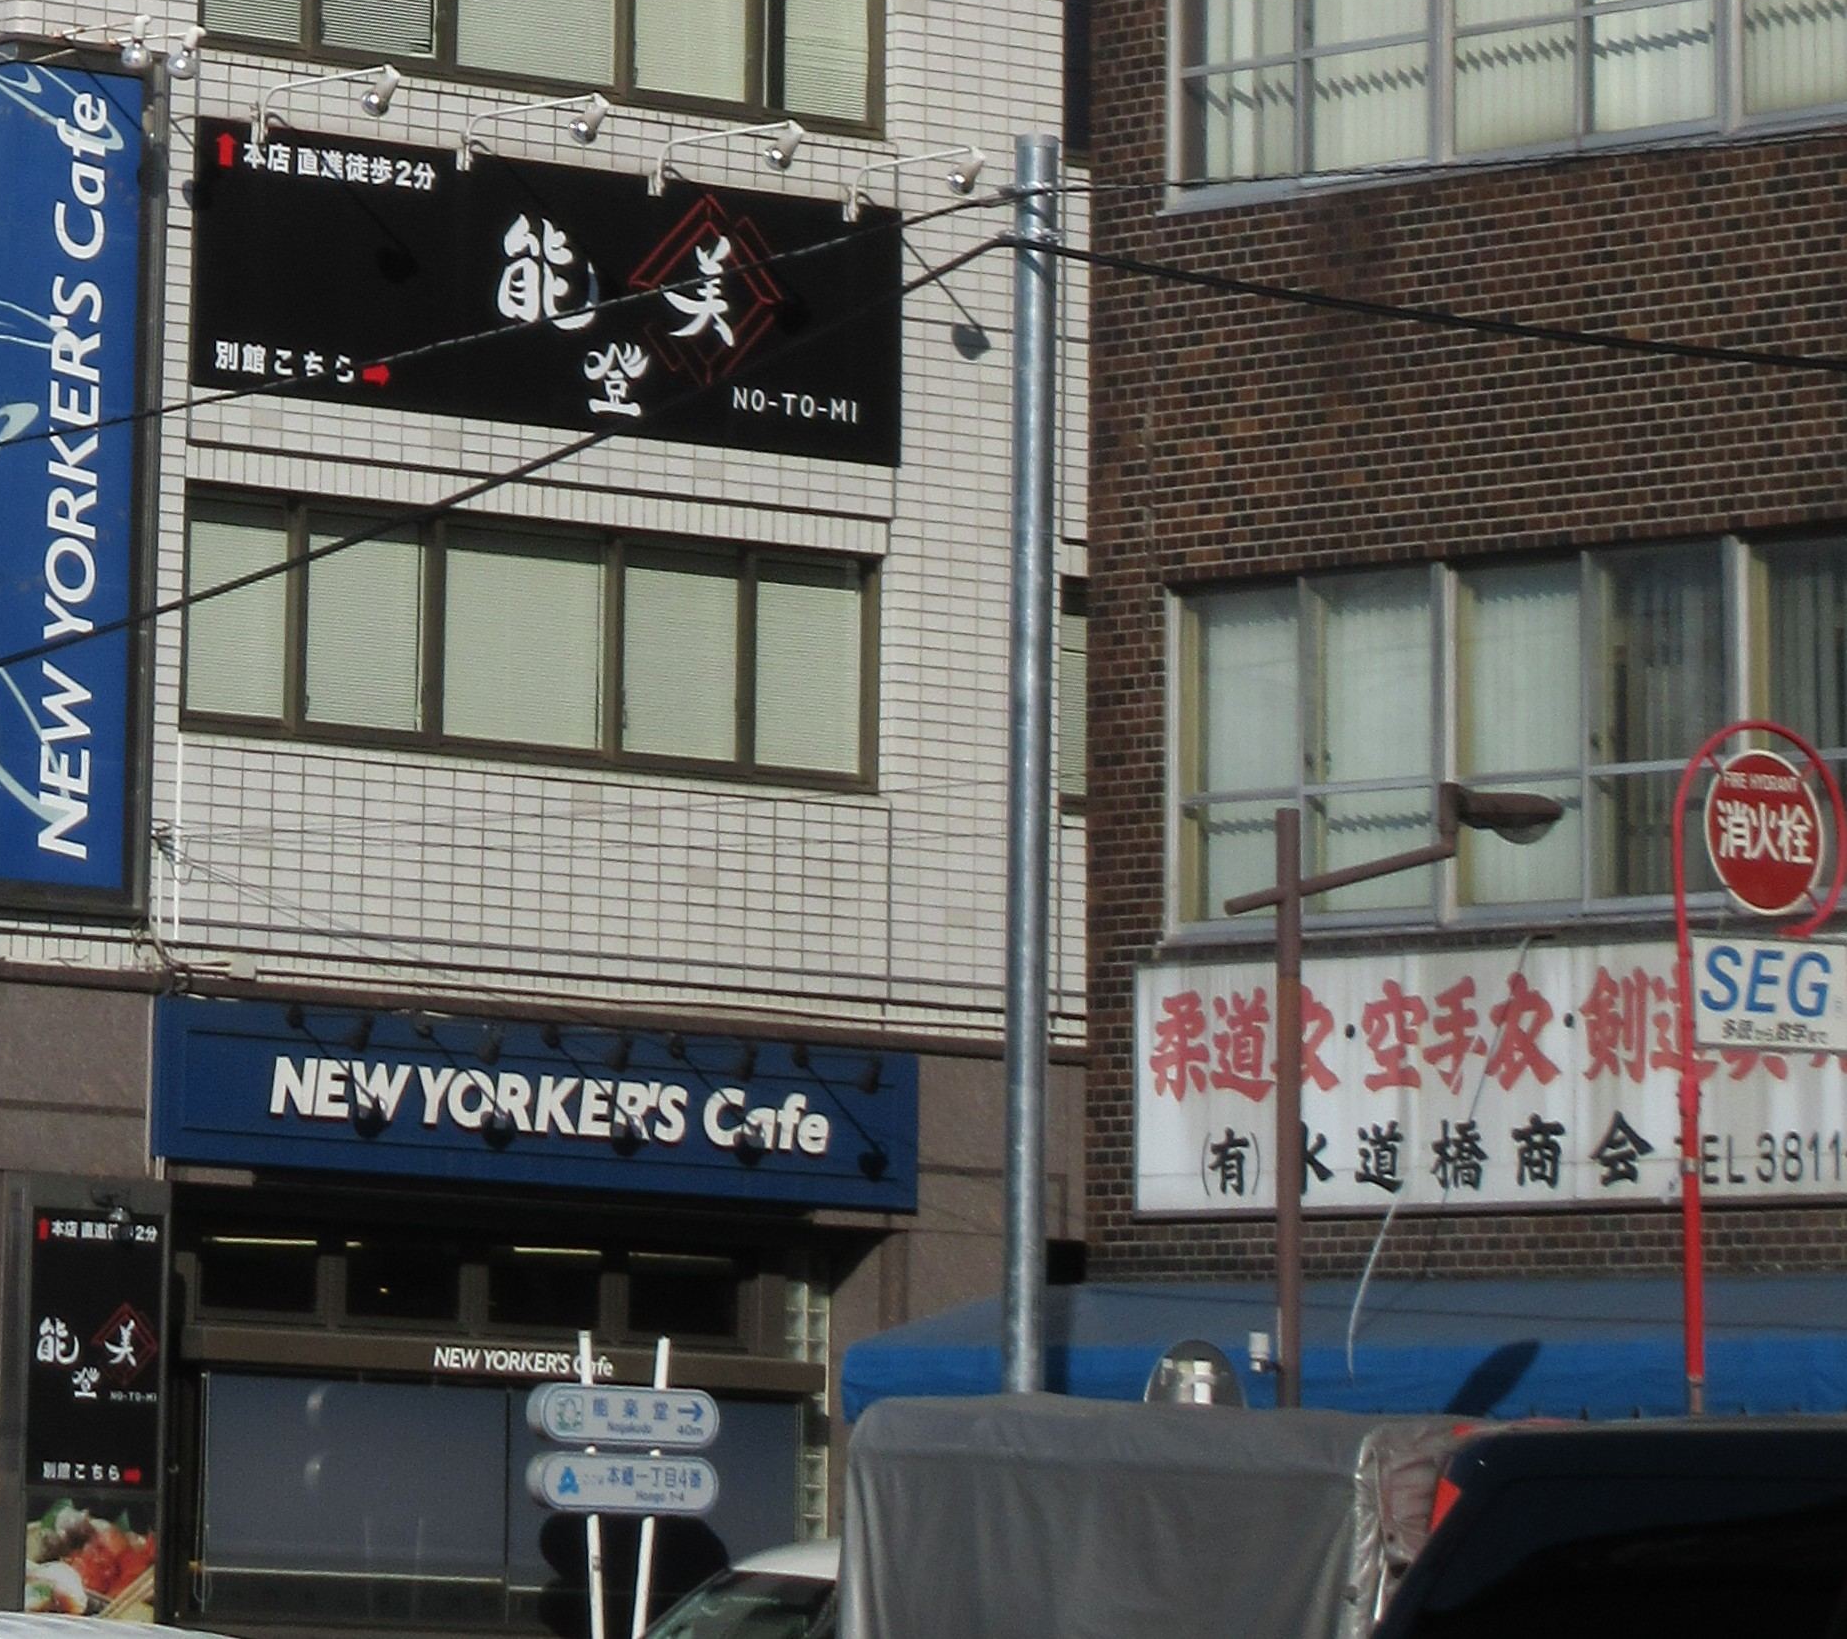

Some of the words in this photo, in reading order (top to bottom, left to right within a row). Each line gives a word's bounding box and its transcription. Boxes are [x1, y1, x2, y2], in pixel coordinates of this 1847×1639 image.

[53, 92, 108, 261] Cafe
[243, 142, 291, 173] 本店
[733, 385, 859, 423] NO-TO-MI
[42, 273, 105, 645] YORKER'S
[37, 661, 98, 860] NEW
[1724, 772, 1748, 791] FIRE
[1749, 773, 1799, 793] HYDRANT
[1716, 799, 1814, 865] 消火栓
[1699, 944, 1833, 1020] SEG
[269, 1055, 411, 1120] NEW
[418, 1065, 688, 1145] YORKER'S
[703, 1087, 831, 1155] Cafe
[1674, 1133, 1748, 1185] EL
[433, 1346, 482, 1370] NEW
[482, 1348, 572, 1374] YORKER'S
[573, 1355, 615, 1377] Cfe
